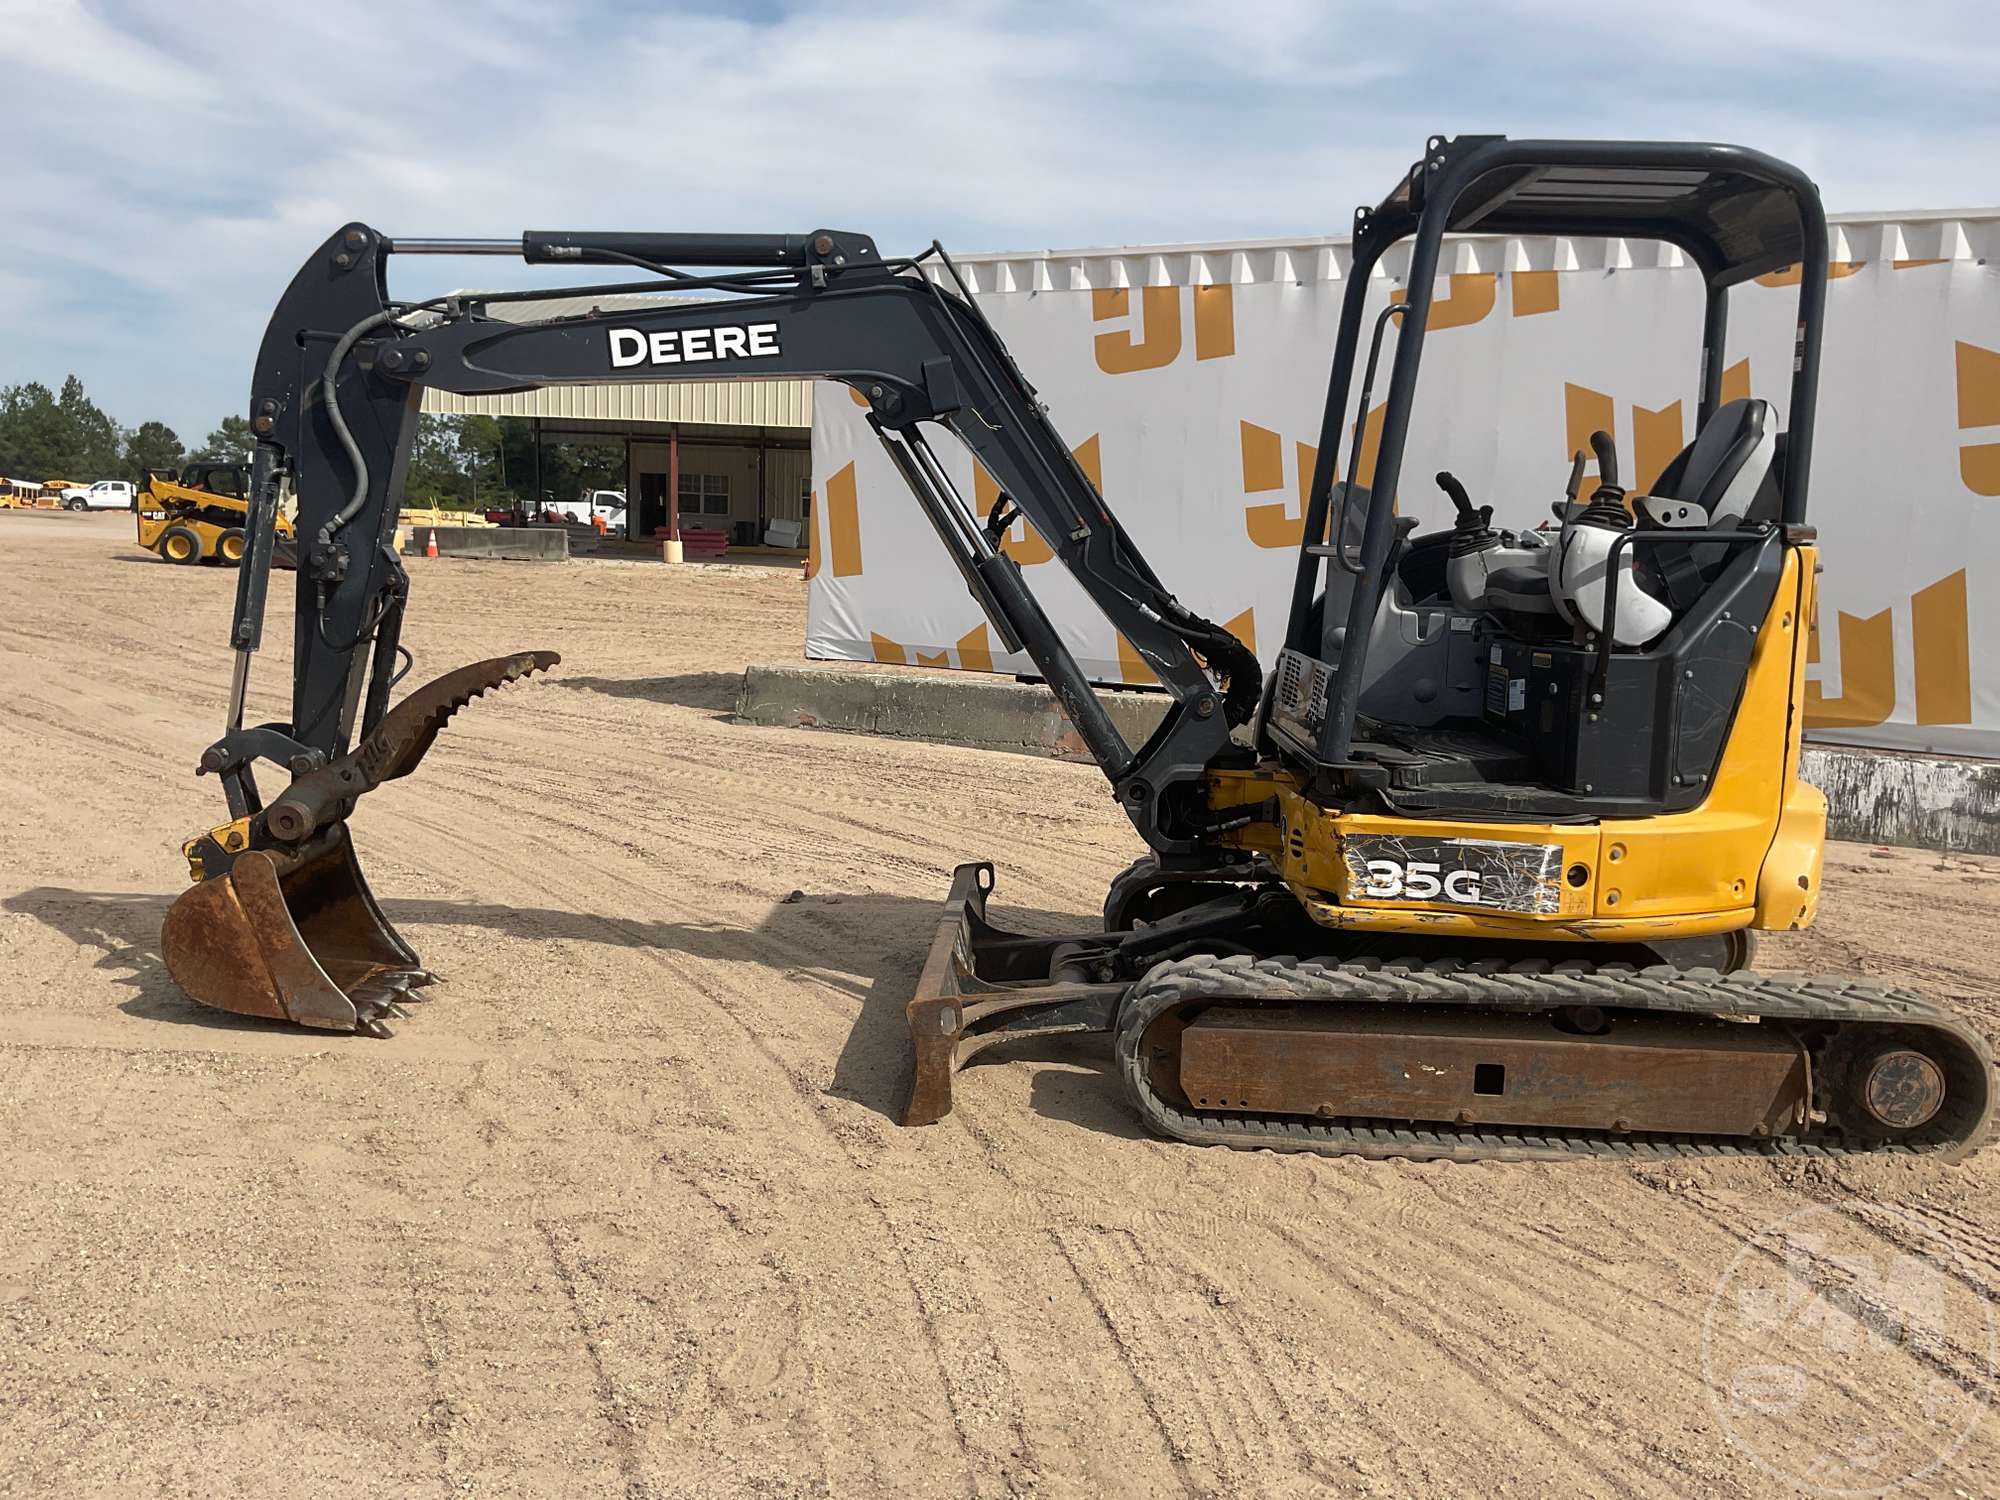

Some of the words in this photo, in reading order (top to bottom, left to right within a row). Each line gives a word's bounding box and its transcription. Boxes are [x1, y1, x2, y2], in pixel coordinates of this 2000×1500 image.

[608, 323, 780, 368] DEERE
[153, 511, 166, 520] CAT
[1366, 859, 1481, 903] 35G
